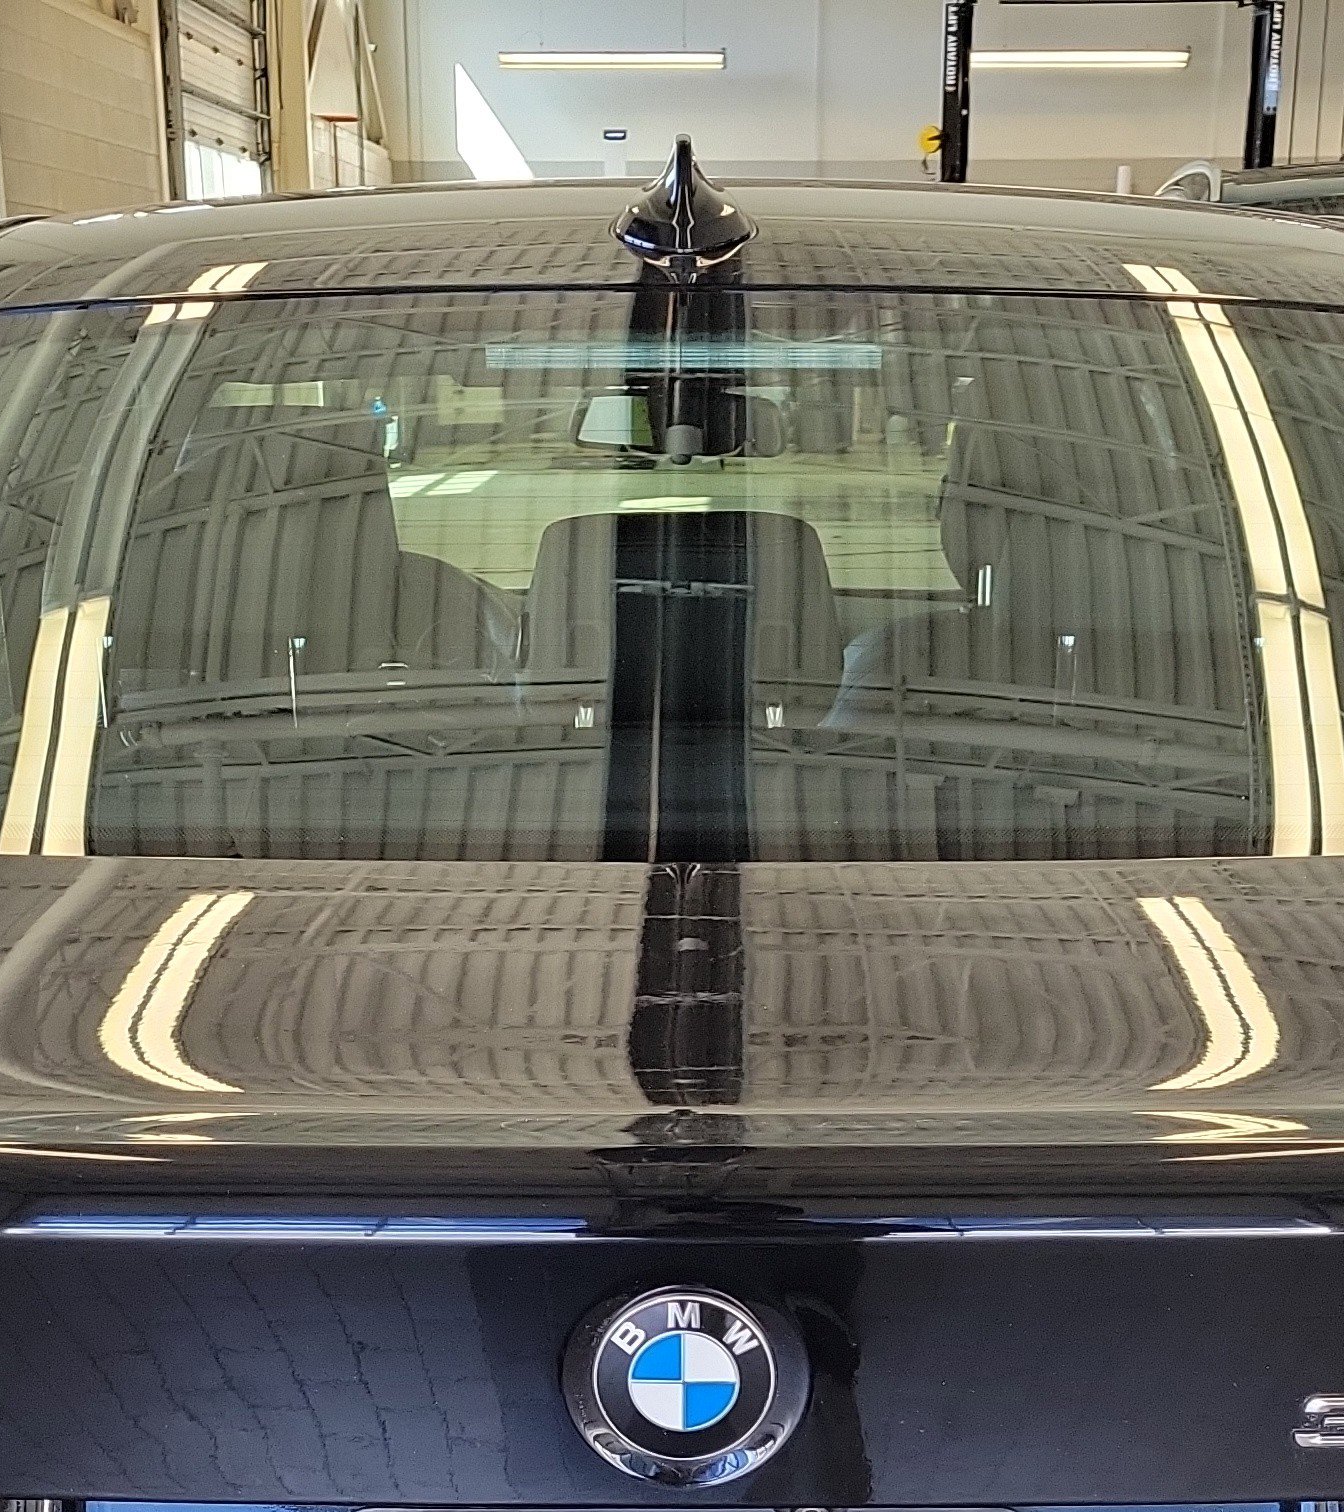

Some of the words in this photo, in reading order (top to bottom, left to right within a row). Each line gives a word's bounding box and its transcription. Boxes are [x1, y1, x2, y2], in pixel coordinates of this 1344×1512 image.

[947, 5, 959, 32] LIFT
[1272, 3, 1284, 29] LIFT
[945, 33, 958, 85] ROTARY
[610, 1302, 759, 1356] BMW
